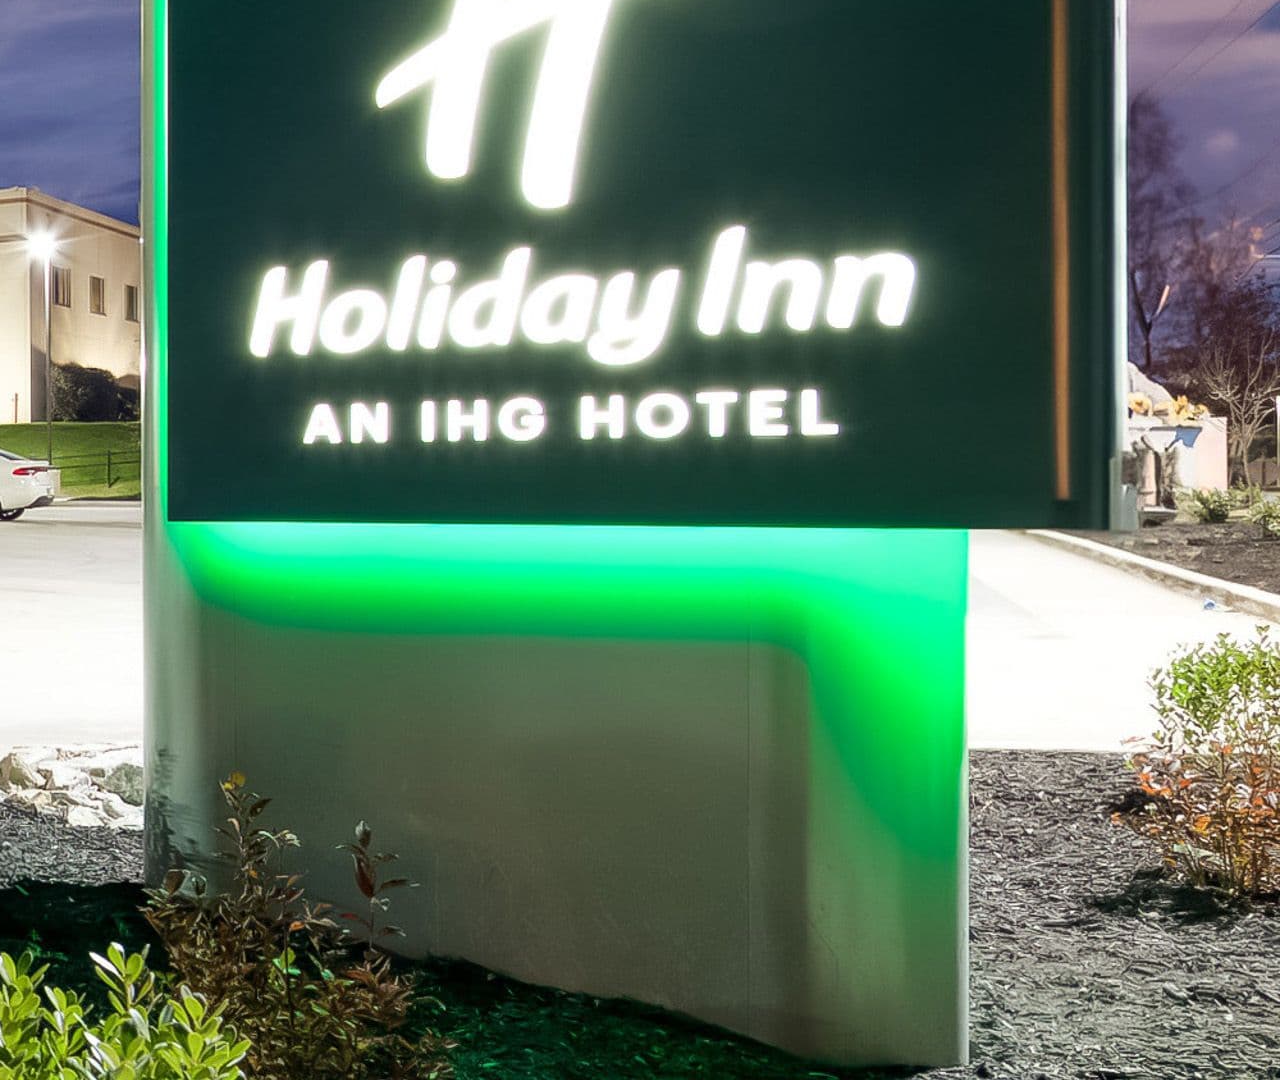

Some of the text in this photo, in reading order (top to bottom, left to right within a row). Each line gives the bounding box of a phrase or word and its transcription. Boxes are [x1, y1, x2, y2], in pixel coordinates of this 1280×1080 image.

[249, 224, 918, 368] Holiday Inn
[302, 387, 840, 444] AN IHG HOTEL
